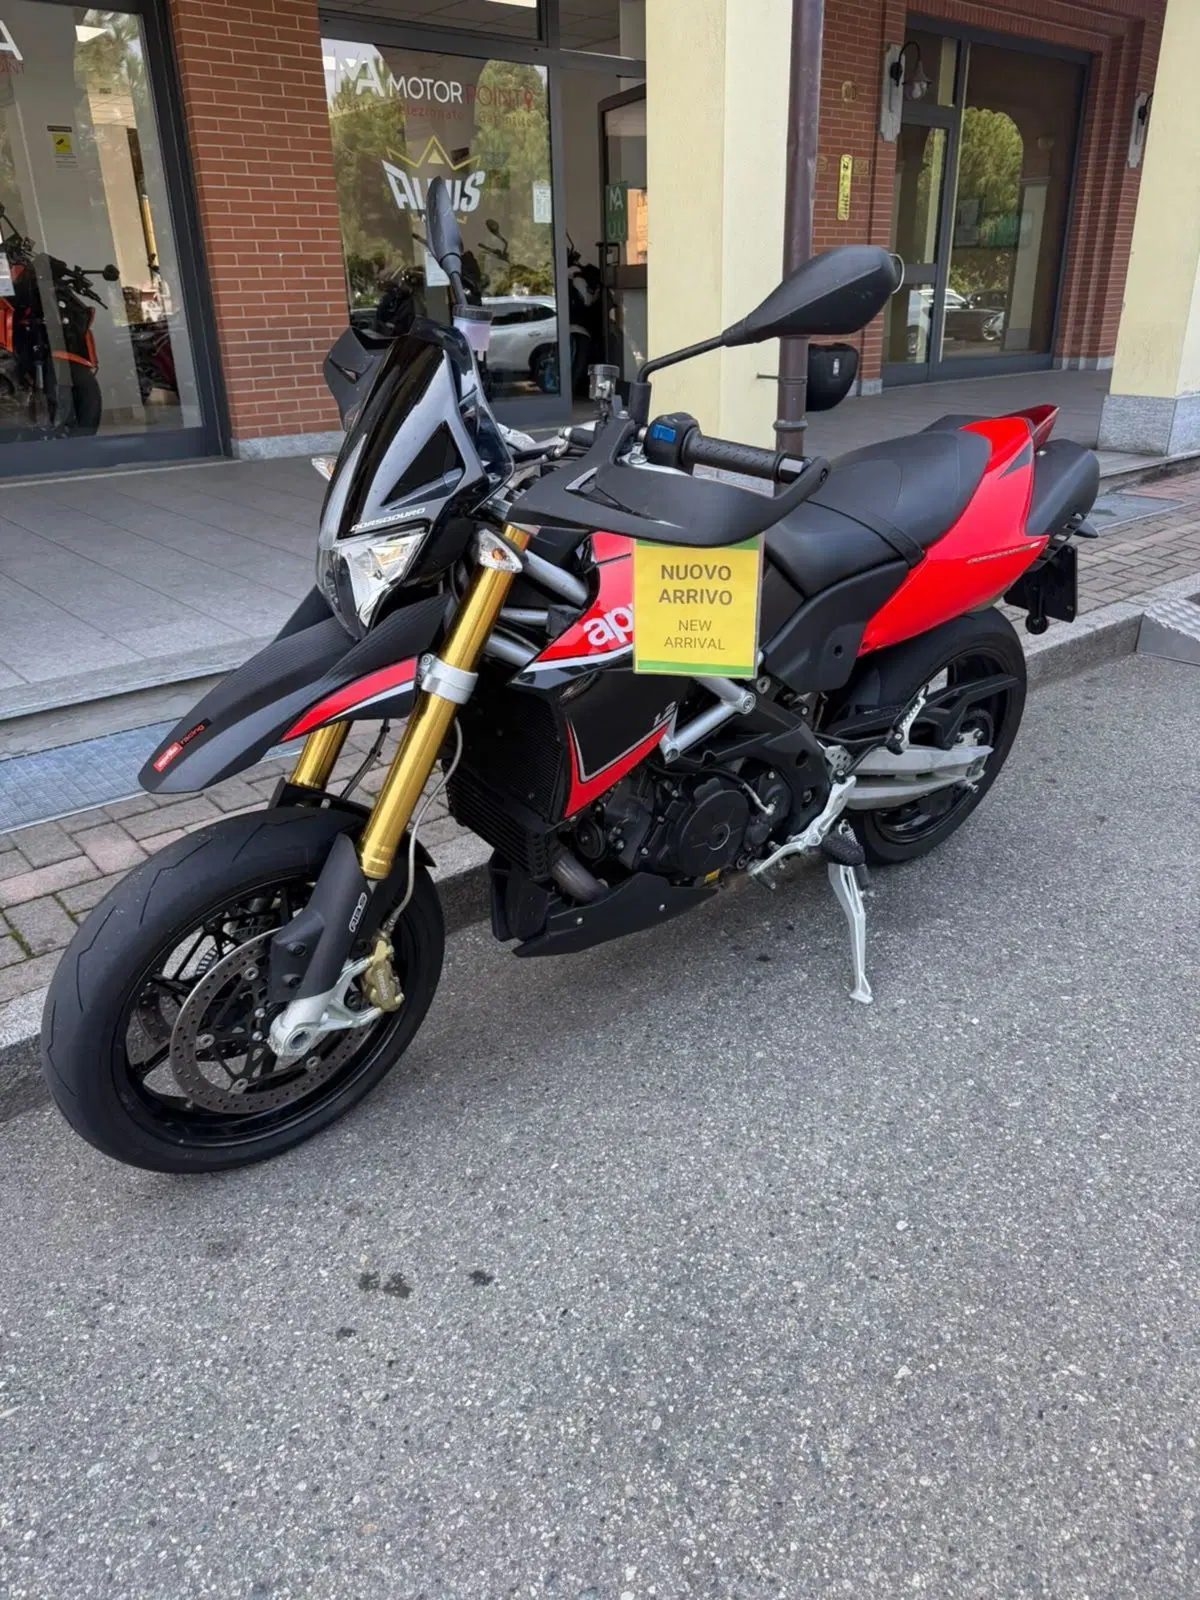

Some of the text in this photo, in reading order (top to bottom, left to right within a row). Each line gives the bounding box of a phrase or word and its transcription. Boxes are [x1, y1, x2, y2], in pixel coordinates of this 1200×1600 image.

[381, 160, 486, 212] ALUS
[660, 564, 732, 581] NUOVO
[658, 588, 733, 606] ARRIVO
[678, 619, 712, 632] NEW
[663, 636, 725, 651] ARRIVAL
[348, 892, 368, 933] ABS
